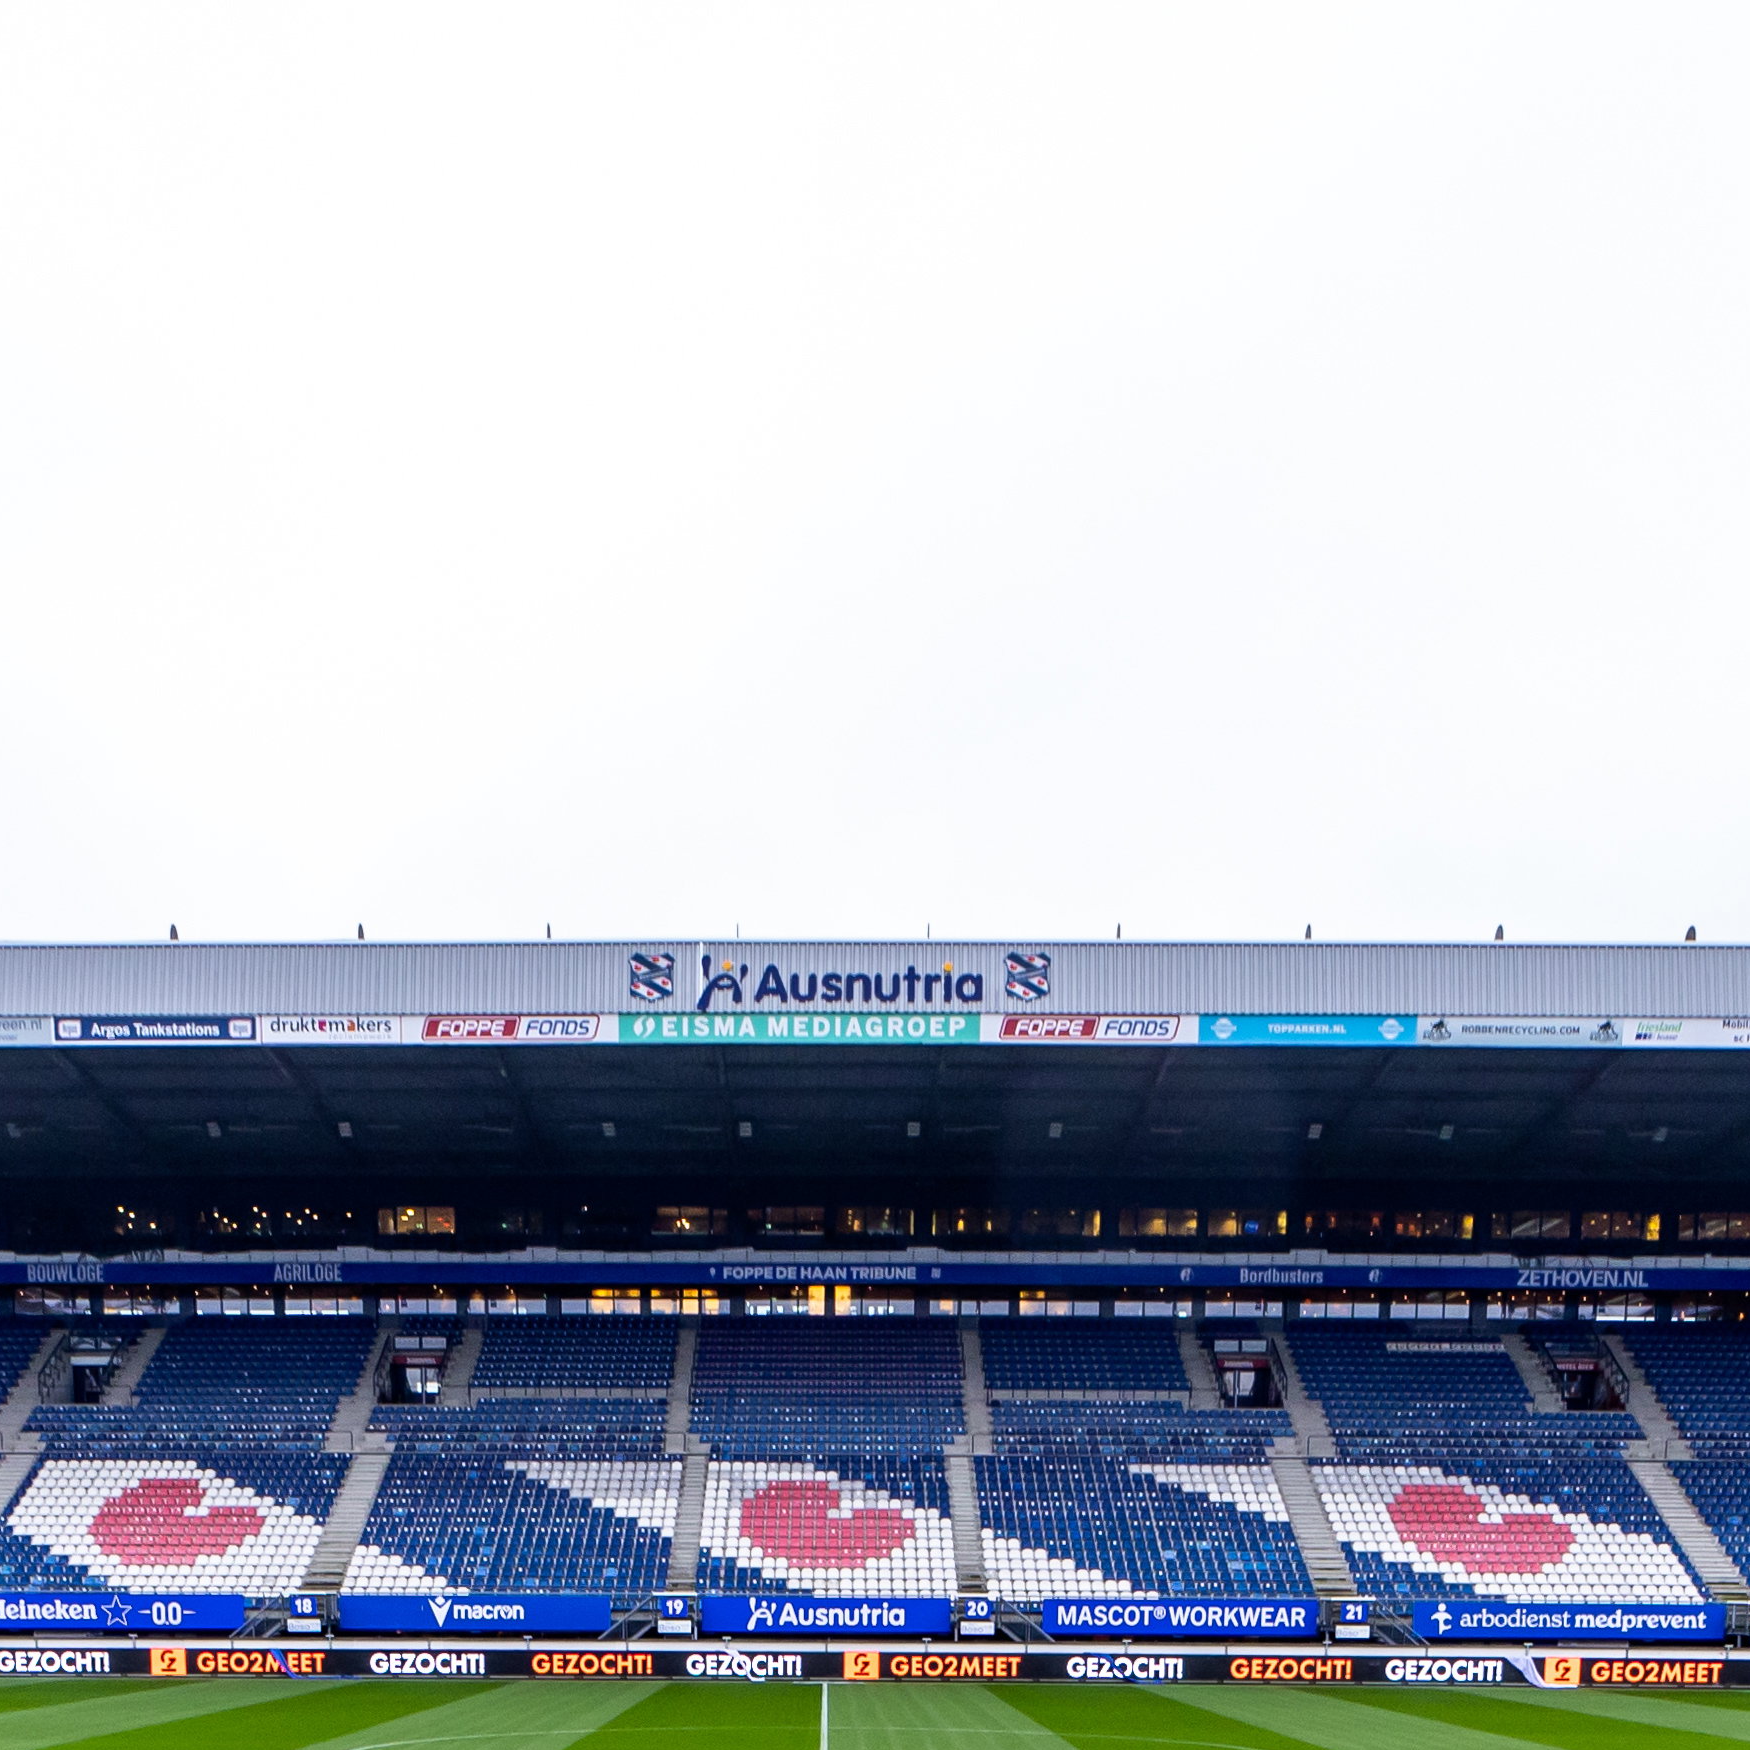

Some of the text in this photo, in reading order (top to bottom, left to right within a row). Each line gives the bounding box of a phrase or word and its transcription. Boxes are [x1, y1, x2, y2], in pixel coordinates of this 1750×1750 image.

[754, 963, 984, 1003] Ausnutria
[89, 1021, 131, 1041] Argos
[134, 1021, 220, 1038] Tankstations
[270, 1017, 392, 1034] druktemakers
[435, 1019, 591, 1039] FOPPE FONDS
[662, 1017, 967, 1039] EISMA MEDIAGROEP
[1014, 1019, 1170, 1039] FOPPE FONDS
[1460, 1024, 1582, 1037] ROBBENRECYCLING.COM
[27, 1262, 104, 1284] BOUWLOGE
[273, 1261, 342, 1283] AGRILOGE
[723, 1266, 917, 1280] FOPPE DE HAAN TRIBUNE
[1239, 1267, 1324, 1284] Bordbusters
[1516, 1268, 1648, 1288] ZETHOVEN.NL
[294, 1597, 313, 1614] 18
[453, 1604, 525, 1620] macron
[665, 1598, 684, 1615] 19
[778, 1601, 906, 1627] Ausnutria
[967, 1600, 989, 1617] 20
[1168, 1605, 1306, 1628] WORKWEAR
[1345, 1603, 1363, 1620] 21
[1459, 1608, 1707, 1633] arbodienst medprevent
[196, 1651, 326, 1674] GEO2MEET
[369, 1652, 486, 1675] GEZOCHT!
[531, 1652, 653, 1675] GEZOCHT!
[685, 1653, 804, 1677] GEZOCHT!
[890, 1655, 1022, 1677] GEO2MEET
[1066, 1655, 1184, 1679] GEZOCHT!
[1230, 1657, 1352, 1680] GEZOCHT!
[1384, 1658, 1503, 1683] GEZOCHT!
[1590, 1660, 1724, 1684] GEO2MEET
